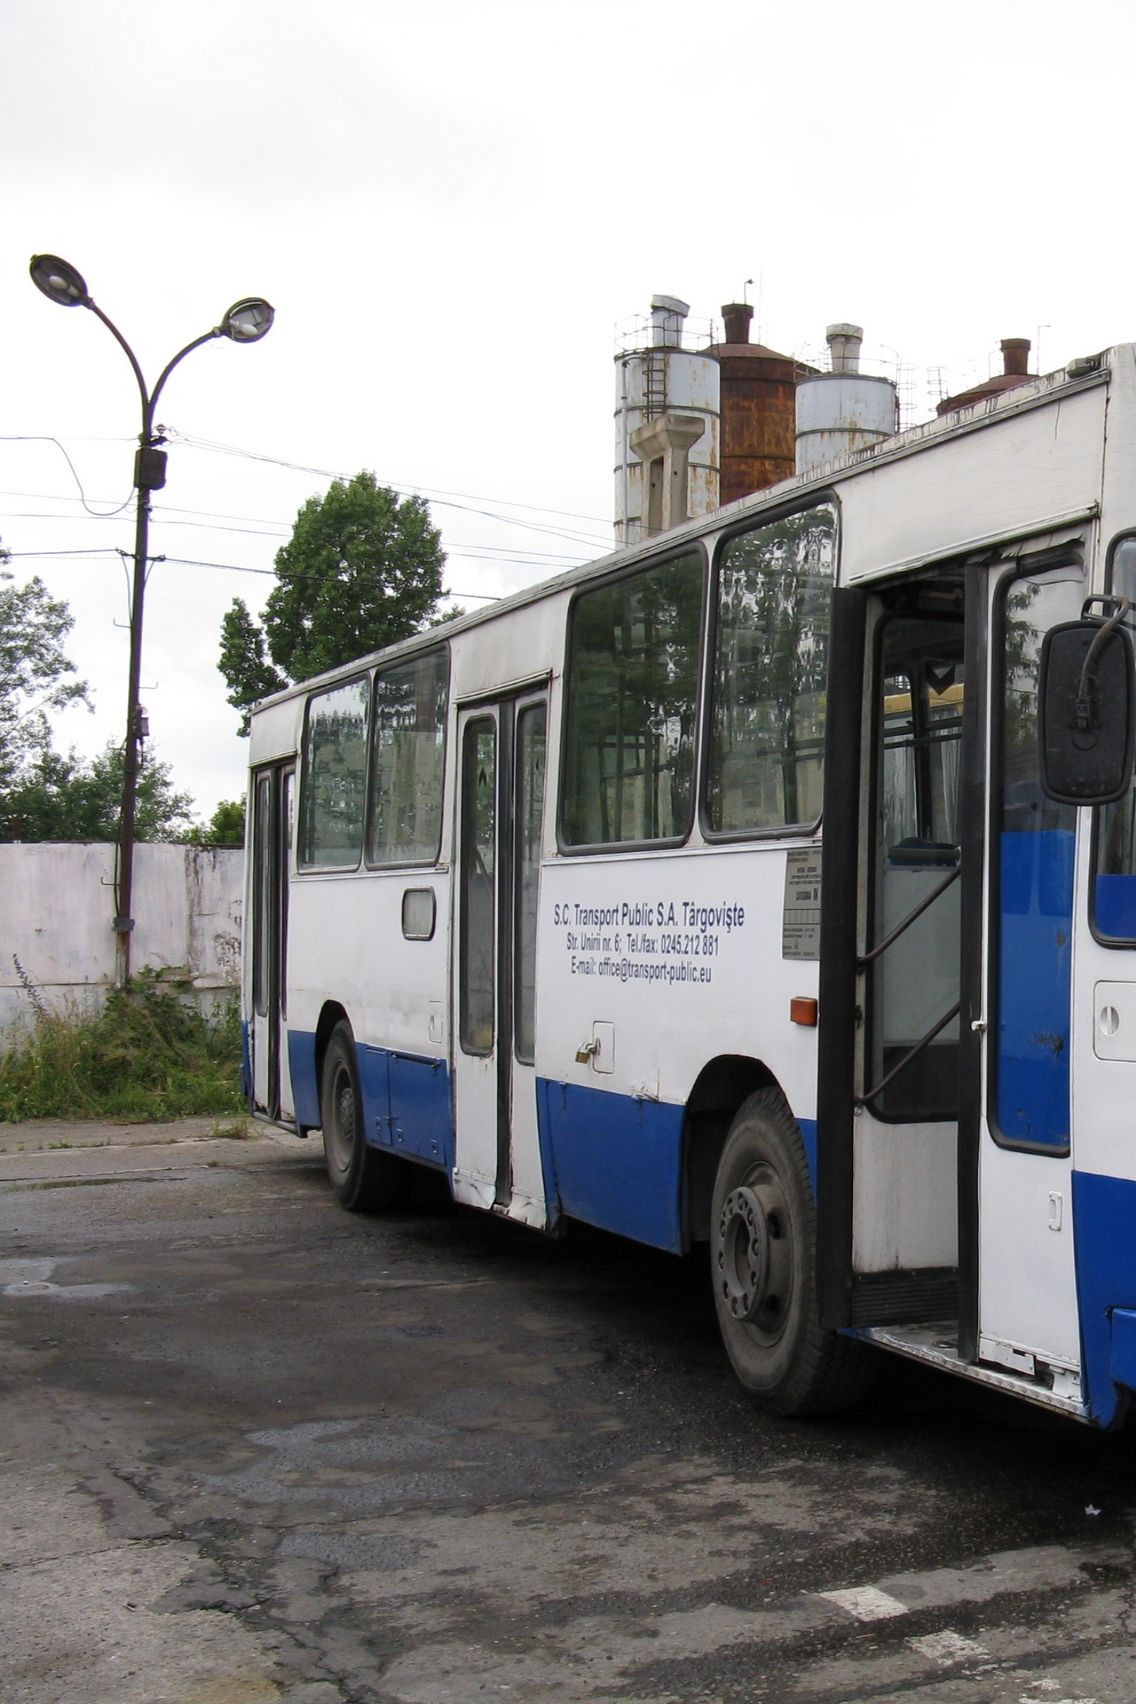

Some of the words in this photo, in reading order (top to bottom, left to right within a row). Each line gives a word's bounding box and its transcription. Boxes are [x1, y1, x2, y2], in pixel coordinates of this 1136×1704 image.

[554, 904, 571, 926] S.C.
[574, 903, 619, 931] Transport
[621, 902, 654, 927] Public
[656, 902, 679, 927] S.A.
[567, 932, 579, 951] Str.
[581, 932, 601, 951] Unirii
[602, 936, 612, 952] nr.
[614, 933, 622, 955] 6;
[661, 934, 700, 956] 0245.212
[702, 935, 719, 956] 881
[571, 956, 597, 976] E-mail:
[598, 957, 712, 985] office@transport-public.eu
